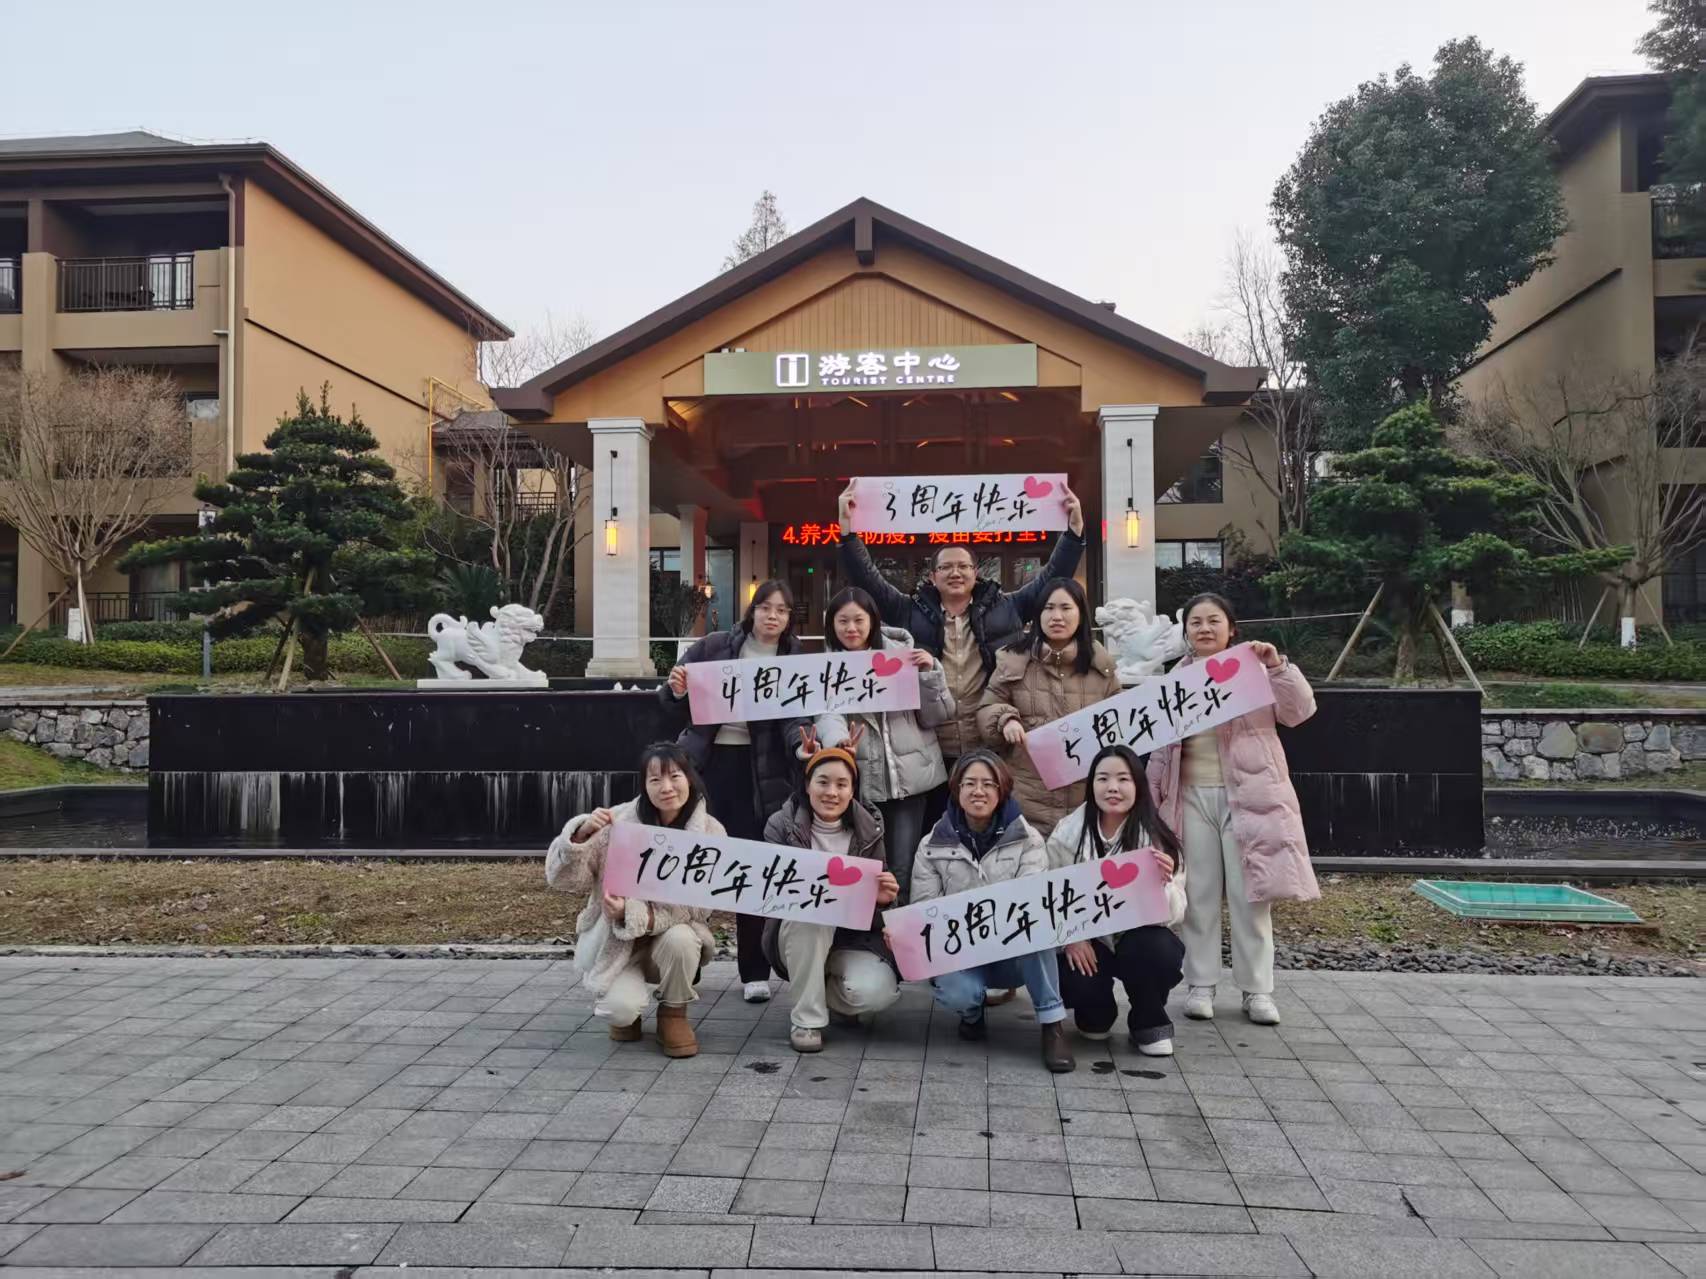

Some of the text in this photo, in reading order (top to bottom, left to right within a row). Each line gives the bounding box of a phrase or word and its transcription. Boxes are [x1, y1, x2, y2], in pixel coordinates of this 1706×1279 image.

[818, 352, 960, 377] 游客中心
[821, 374, 955, 386] TOURIST CENTRE
[636, 844, 838, 910] 10周年快乐
[920, 879, 1126, 962] 18周年快乐
